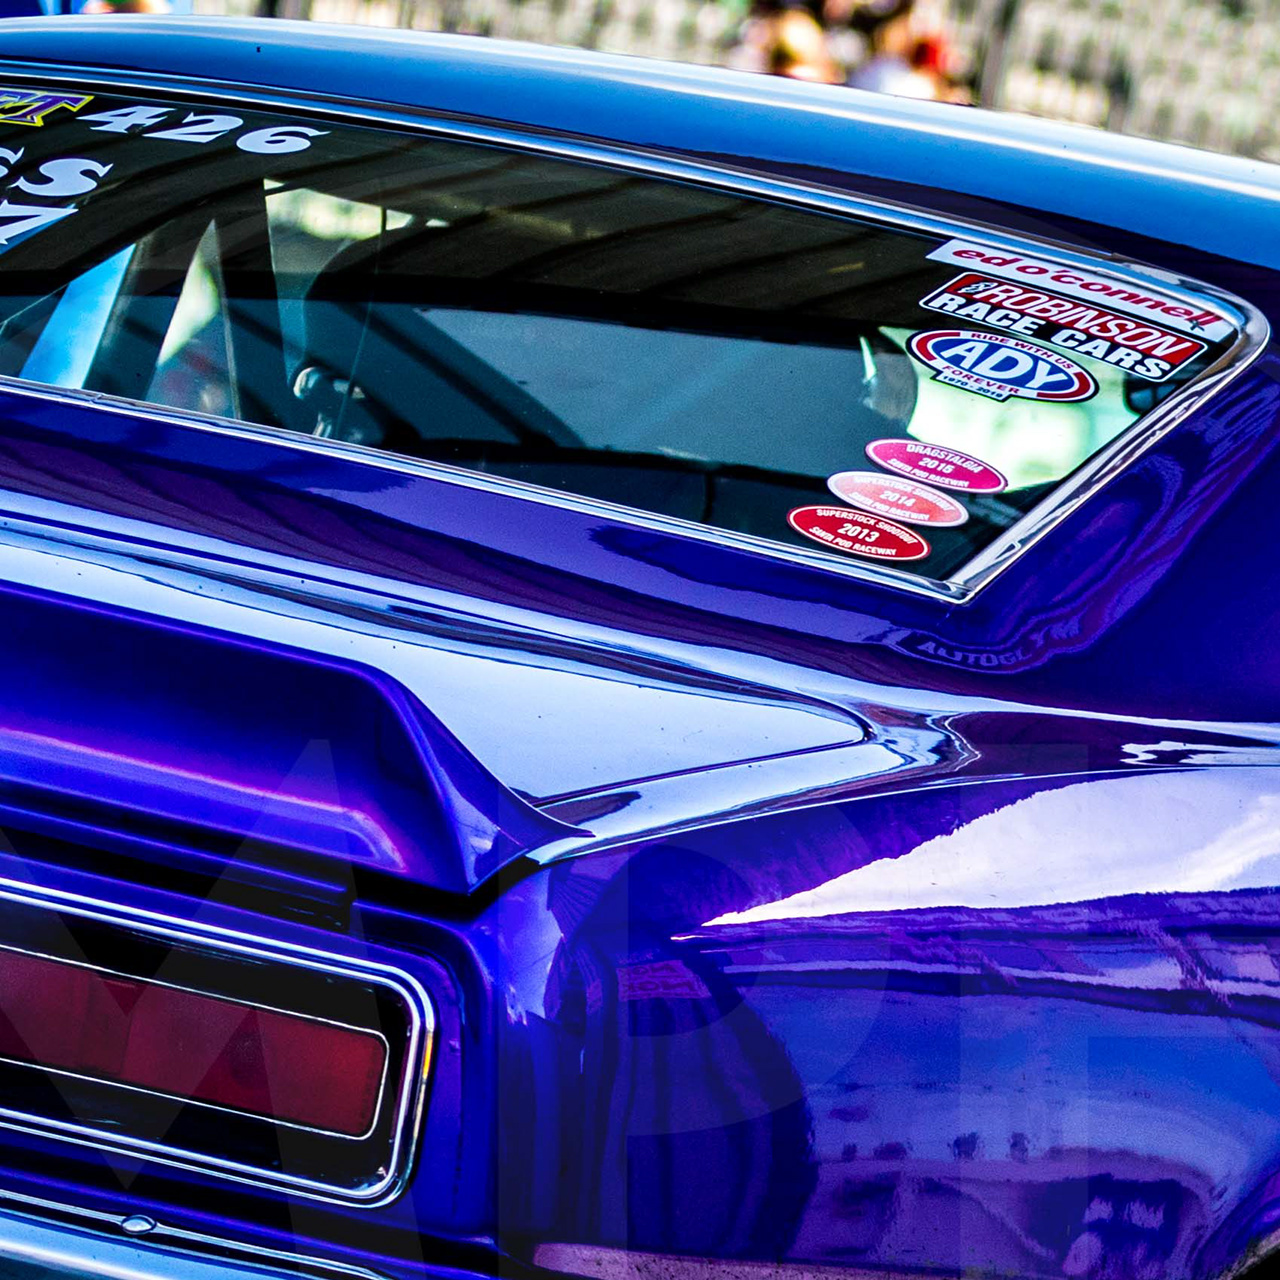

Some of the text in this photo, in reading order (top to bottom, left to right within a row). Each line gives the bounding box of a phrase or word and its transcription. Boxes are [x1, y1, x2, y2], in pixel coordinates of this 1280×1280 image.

[76, 105, 332, 154] 426
[952, 249, 1222, 327] ed o'connell
[928, 292, 1170, 379] RACE CARS
[984, 284, 1192, 358] ROBINSON
[939, 341, 1069, 389] ADY
[971, 332, 1074, 369] RIDE WITH US
[942, 365, 1021, 395] FOREVER
[906, 443, 985, 474] DRAGSTALGIA
[911, 468, 930, 480] POD
[927, 474, 971, 488] RACEWAY
[879, 490, 917, 508] 2014
[815, 508, 878, 526] SUPERSTOCK
[836, 522, 880, 543] 2013
[808, 526, 897, 556] SANTA POD RACEWAY
